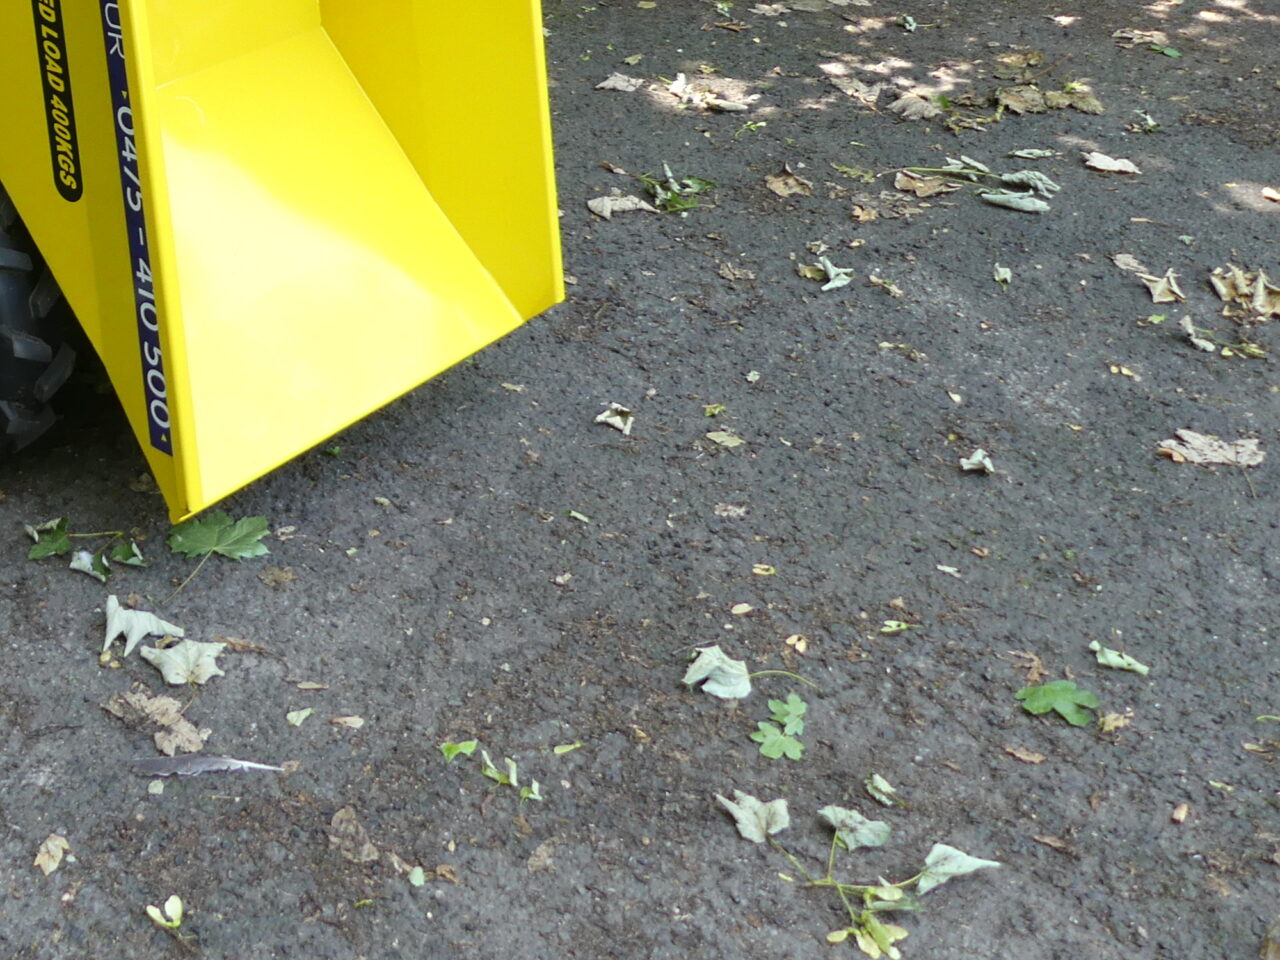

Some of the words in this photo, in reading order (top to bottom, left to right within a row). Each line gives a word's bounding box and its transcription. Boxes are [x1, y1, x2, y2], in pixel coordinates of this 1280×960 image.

[41, 24, 65, 92] LOAD
[50, 94, 77, 189] 400KGS
[117, 106, 142, 212] 0475
[136, 257, 159, 331] 410
[143, 341, 170, 428] 500
